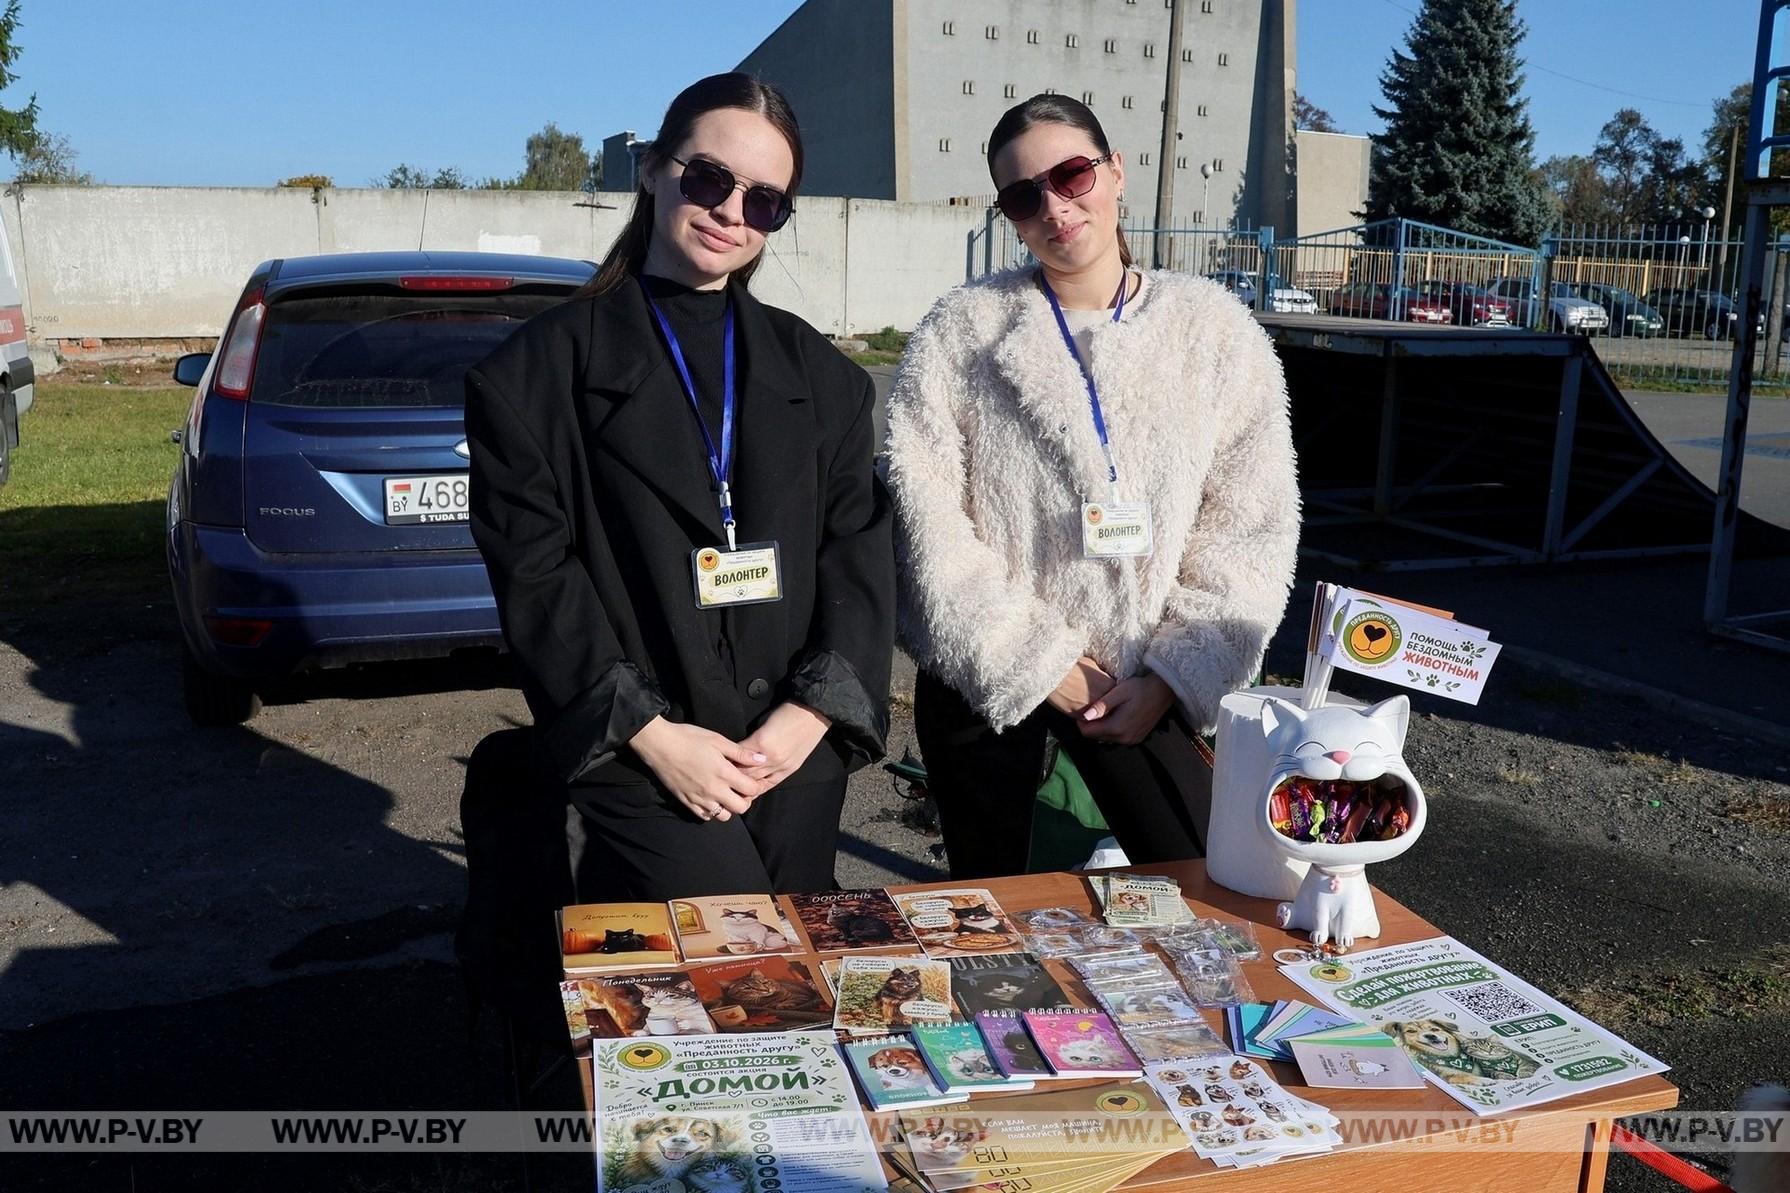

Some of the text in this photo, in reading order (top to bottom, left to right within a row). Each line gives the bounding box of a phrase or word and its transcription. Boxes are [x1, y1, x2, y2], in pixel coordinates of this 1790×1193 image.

[259, 507, 316, 516] FOCUS
[392, 500, 408, 513] BY
[428, 513, 456, 521] TUDA
[1098, 525, 1142, 539] ВОЛОНТЕР
[714, 566, 769, 587] ВОЛОНТЕР
[1409, 632, 1458, 652] ПОМОЩЬ
[1406, 641, 1474, 667] БЕЗДОМНЫМ
[1402, 651, 1481, 682] ЖИВОТНЫМ
[1360, 957, 1426, 975] «Преданность
[602, 976, 673, 987] Понедельник
[1337, 961, 1483, 1001] Сделай пожертвование
[1522, 1018, 1558, 1031] ЕРИП
[673, 1038, 734, 1047] Учреждение
[751, 1034, 787, 1042] защите
[704, 1042, 761, 1050] животных
[676, 1044, 801, 1058] «Преданность другу»
[702, 1056, 780, 1070] 03.10.2026
[686, 1067, 767, 1078] состоится акция
[606, 1102, 632, 1112] Добро
[982, 1120, 1005, 1128] ЕСЛИ
[1001, 1123, 1037, 1133] МЕШАЕТ
